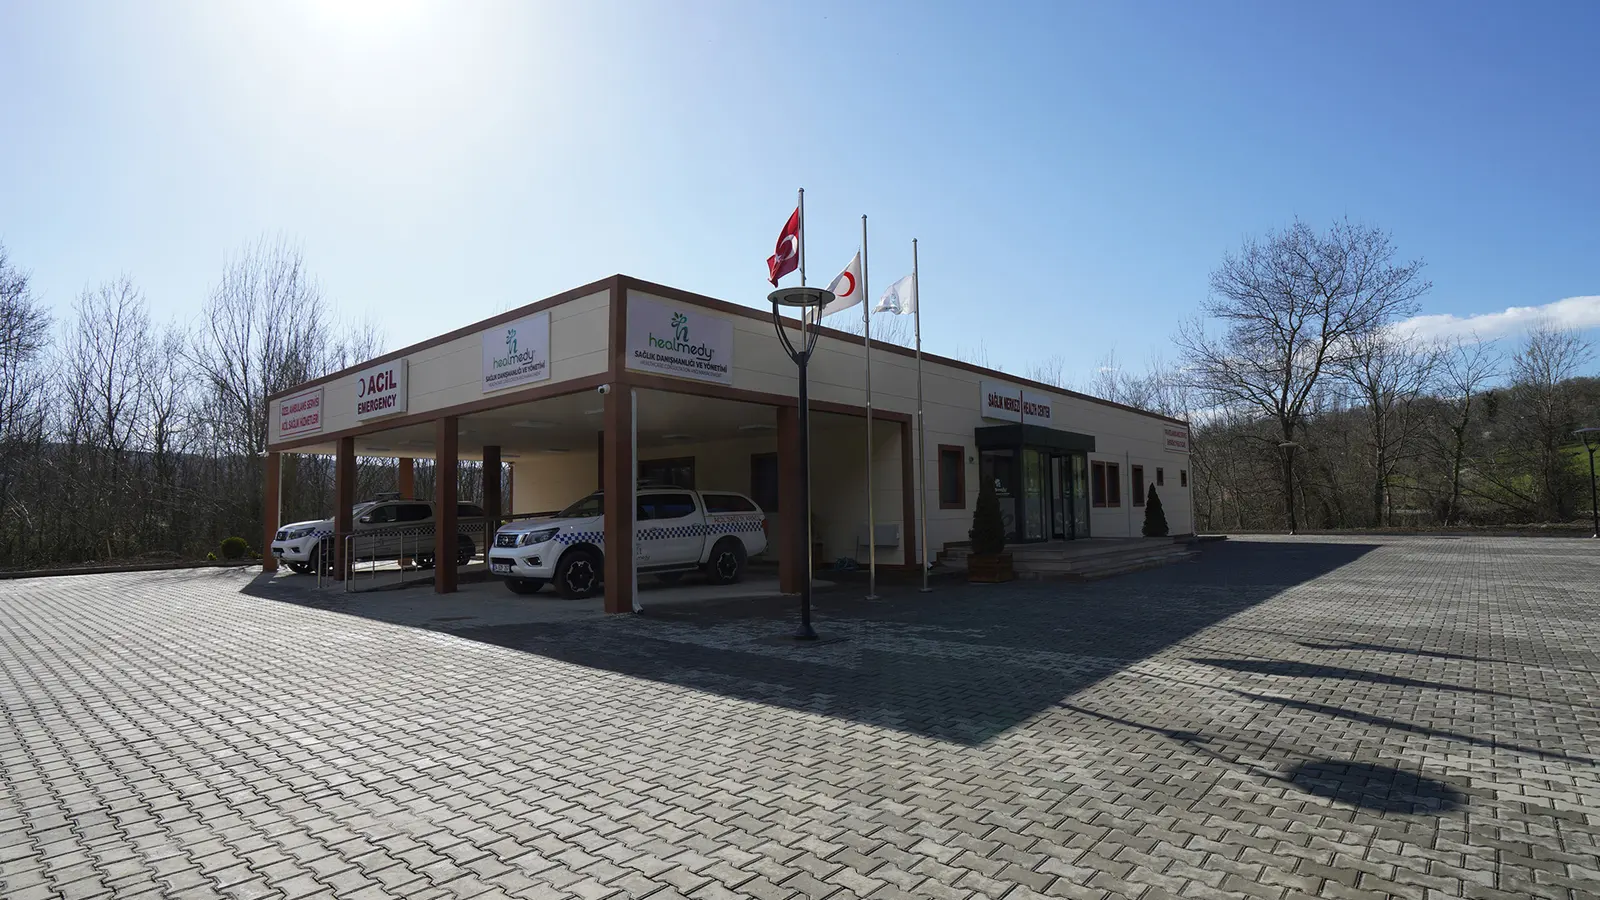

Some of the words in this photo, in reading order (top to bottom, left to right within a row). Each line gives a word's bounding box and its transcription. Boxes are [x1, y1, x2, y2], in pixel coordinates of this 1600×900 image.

[649, 332, 712, 361] healmedy
[493, 348, 534, 369] healmedy
[634, 350, 656, 361] SAĞLIK
[696, 360, 703, 369] VE
[704, 361, 727, 373] YÖNETİMİ
[357, 394, 397, 415] EMERGENCY
